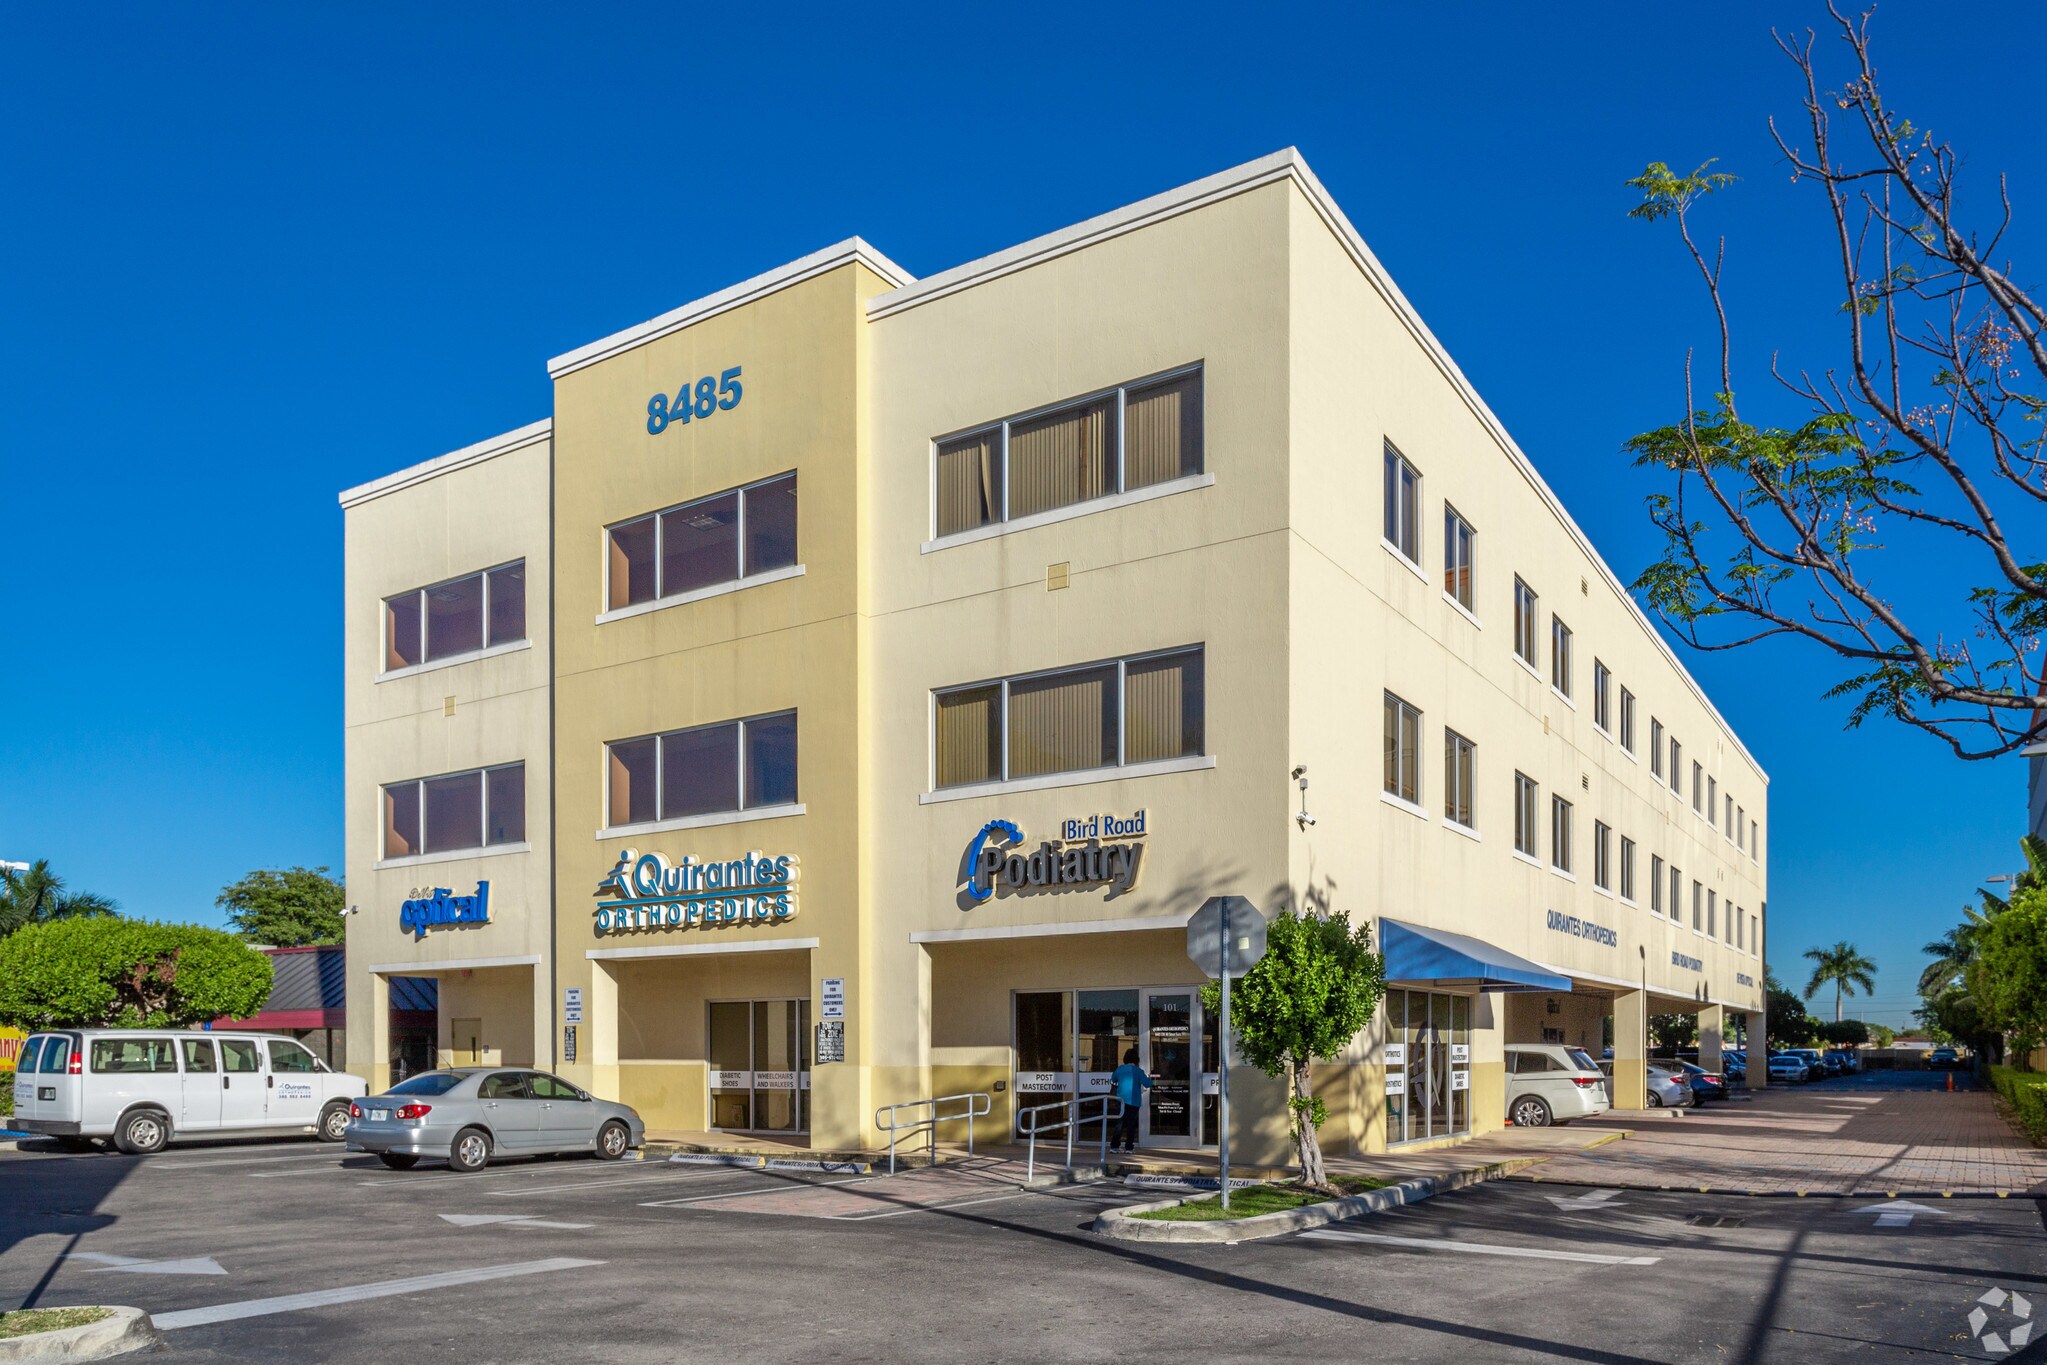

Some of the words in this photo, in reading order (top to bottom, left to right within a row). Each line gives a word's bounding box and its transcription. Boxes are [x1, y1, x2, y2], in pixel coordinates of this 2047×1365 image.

[646, 365, 743, 435] 8485
[1066, 815, 1098, 840] Bird
[1104, 809, 1145, 835] Road
[634, 851, 794, 896] Quirantes
[982, 839, 1143, 892] Podiatry
[400, 880, 490, 935] optical
[597, 893, 794, 930] ORTHOPEDICS
[1547, 909, 1581, 937] QUIRANTES
[1581, 920, 1617, 948] ORTHOPEDICS
[1163, 1003, 1177, 1012] 101
[756, 1072, 794, 1080] WHEELCHAIRS
[1021, 1083, 1068, 1091] MASTECTOMY
[1035, 1073, 1054, 1081] POST
